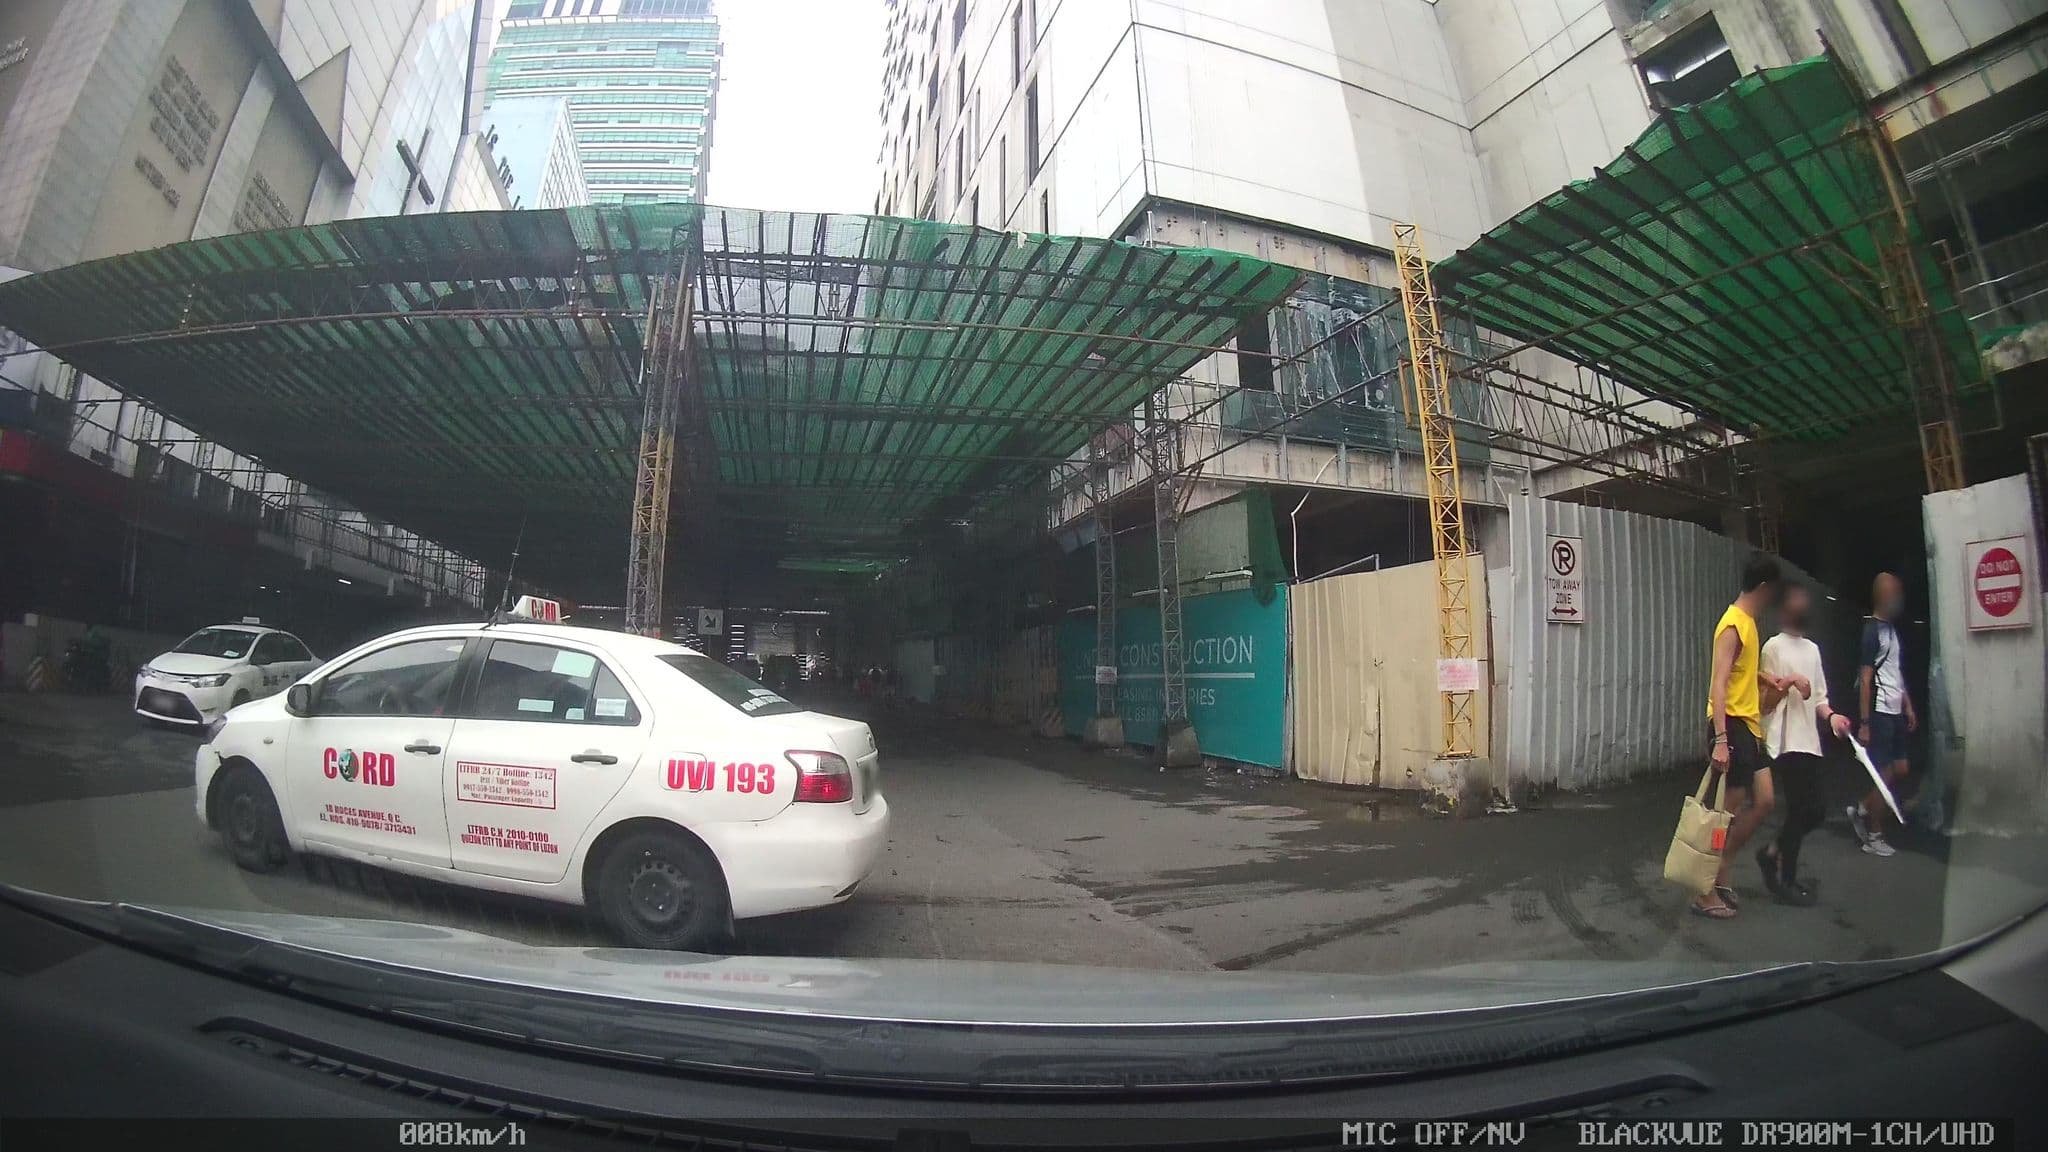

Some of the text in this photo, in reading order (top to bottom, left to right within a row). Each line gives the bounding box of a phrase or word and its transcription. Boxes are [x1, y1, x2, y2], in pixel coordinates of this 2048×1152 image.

[1980, 559, 2015, 575] DO NOT
[1549, 578, 1580, 591] TOW AWAY
[1556, 592, 1571, 604] ZONE
[1984, 591, 2014, 605] ENTER
[1119, 635, 1253, 666] CONSRUCTION
[481, 766, 501, 777] 24/7
[534, 770, 553, 780] 1342
[667, 759, 775, 795] UVI 193
[467, 824, 489, 836] LTFRB
[505, 828, 549, 843] 2010-0100
[461, 834, 558, 854] QUEZON CITY TO ANY POINT OF LUZON
